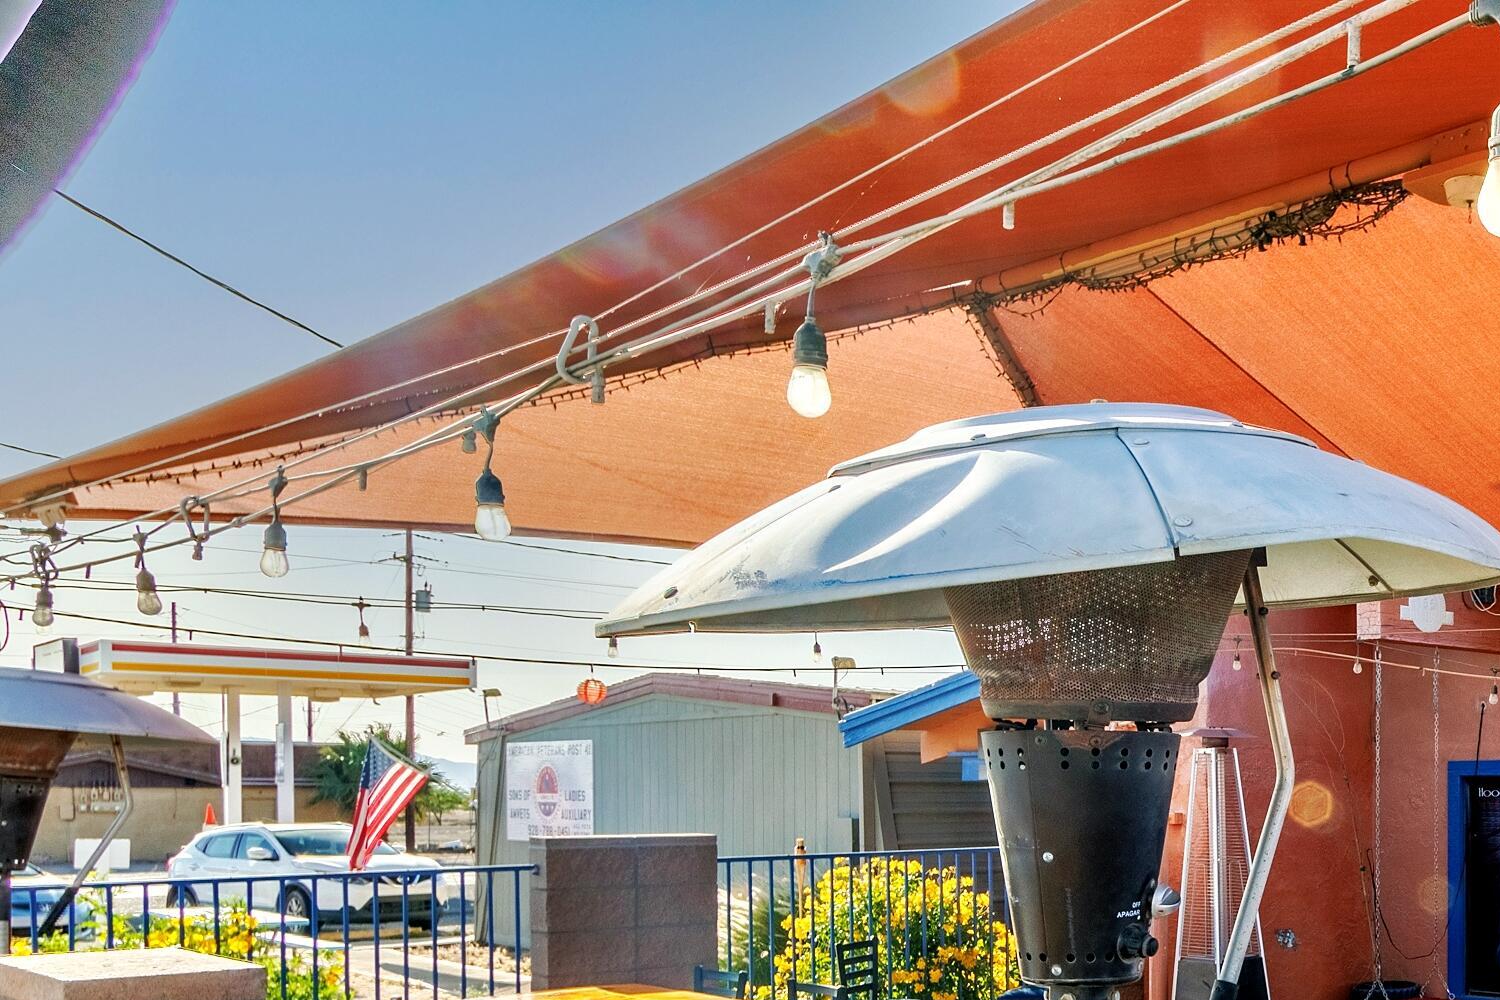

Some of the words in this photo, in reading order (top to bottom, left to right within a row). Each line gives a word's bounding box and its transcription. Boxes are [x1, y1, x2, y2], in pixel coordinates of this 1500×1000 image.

[564, 789, 586, 802] LADIES
[561, 808, 592, 821] AUXILIARY
[1131, 901, 1141, 909] OFF
[1116, 909, 1141, 919] APAGAR
